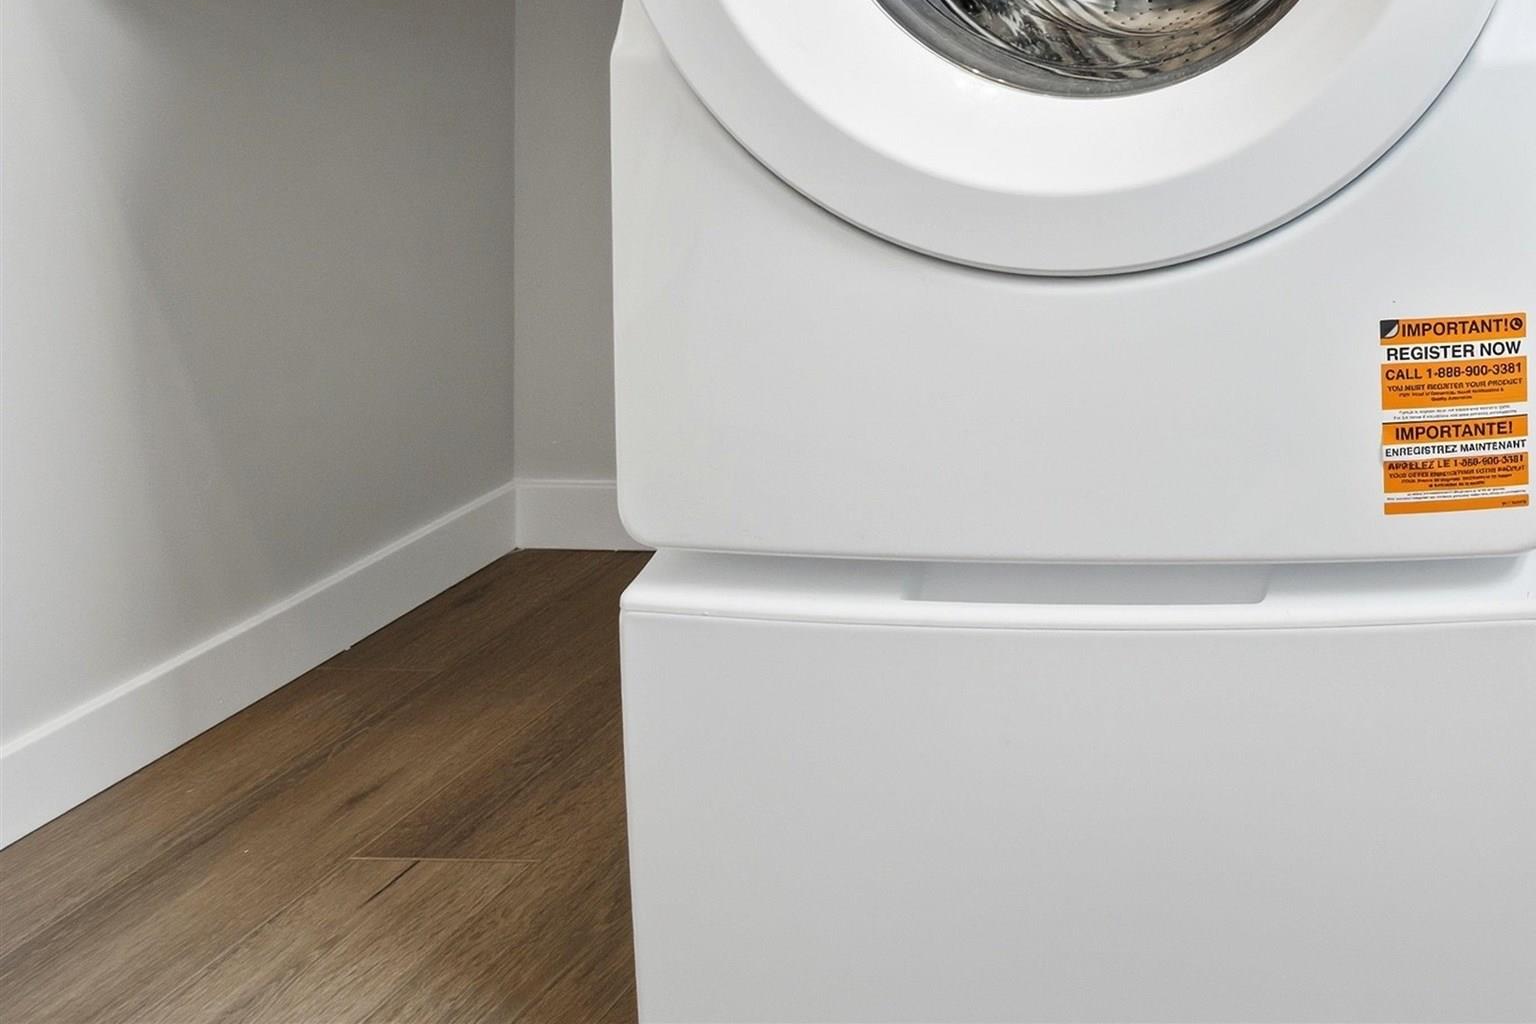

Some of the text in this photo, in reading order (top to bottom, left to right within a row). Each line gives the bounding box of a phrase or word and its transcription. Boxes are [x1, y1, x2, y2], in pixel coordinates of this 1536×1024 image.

[1402, 318, 1508, 337] IMPORTANT!
[1387, 341, 1521, 361] REGISTER NOW
[1385, 362, 1522, 381] CALL 1-888-900-3381
[1395, 421, 1513, 441] IMPORTANTE!
[1385, 439, 1527, 457] ENREGISTREZ MAINTENANT
[1388, 460, 1434, 470] APPELEZ
[1438, 459, 1451, 468] LE
